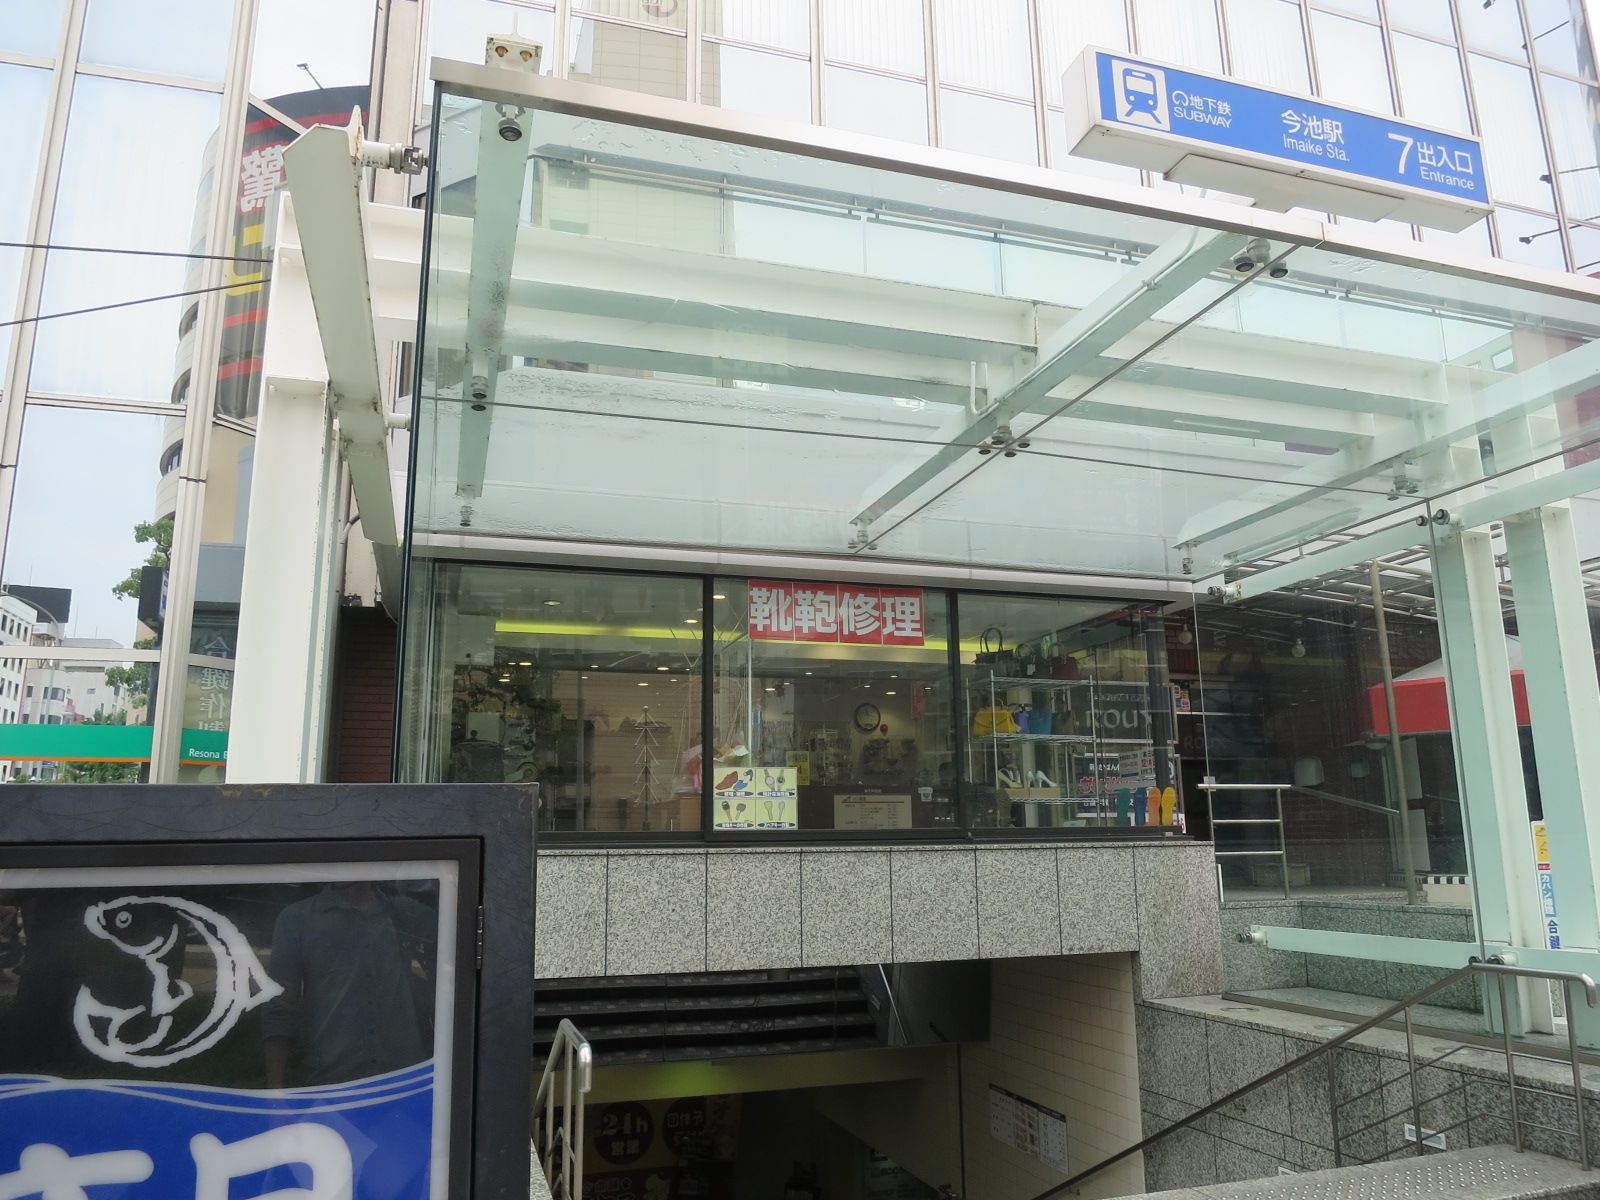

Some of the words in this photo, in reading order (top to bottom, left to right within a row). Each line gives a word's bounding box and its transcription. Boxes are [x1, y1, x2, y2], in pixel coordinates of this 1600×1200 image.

[1172, 106, 1232, 128] SUBWAY
[1280, 109, 1345, 145] 今池駅
[1283, 135, 1323, 156] Imaike
[1326, 144, 1350, 162] Sta.
[1387, 133, 1414, 174] 7
[1417, 141, 1474, 175] 出入口
[1420, 166, 1475, 190] Entrance
[749, 587, 923, 637] 靴鞄修理
[189, 748, 220, 759] Resona
